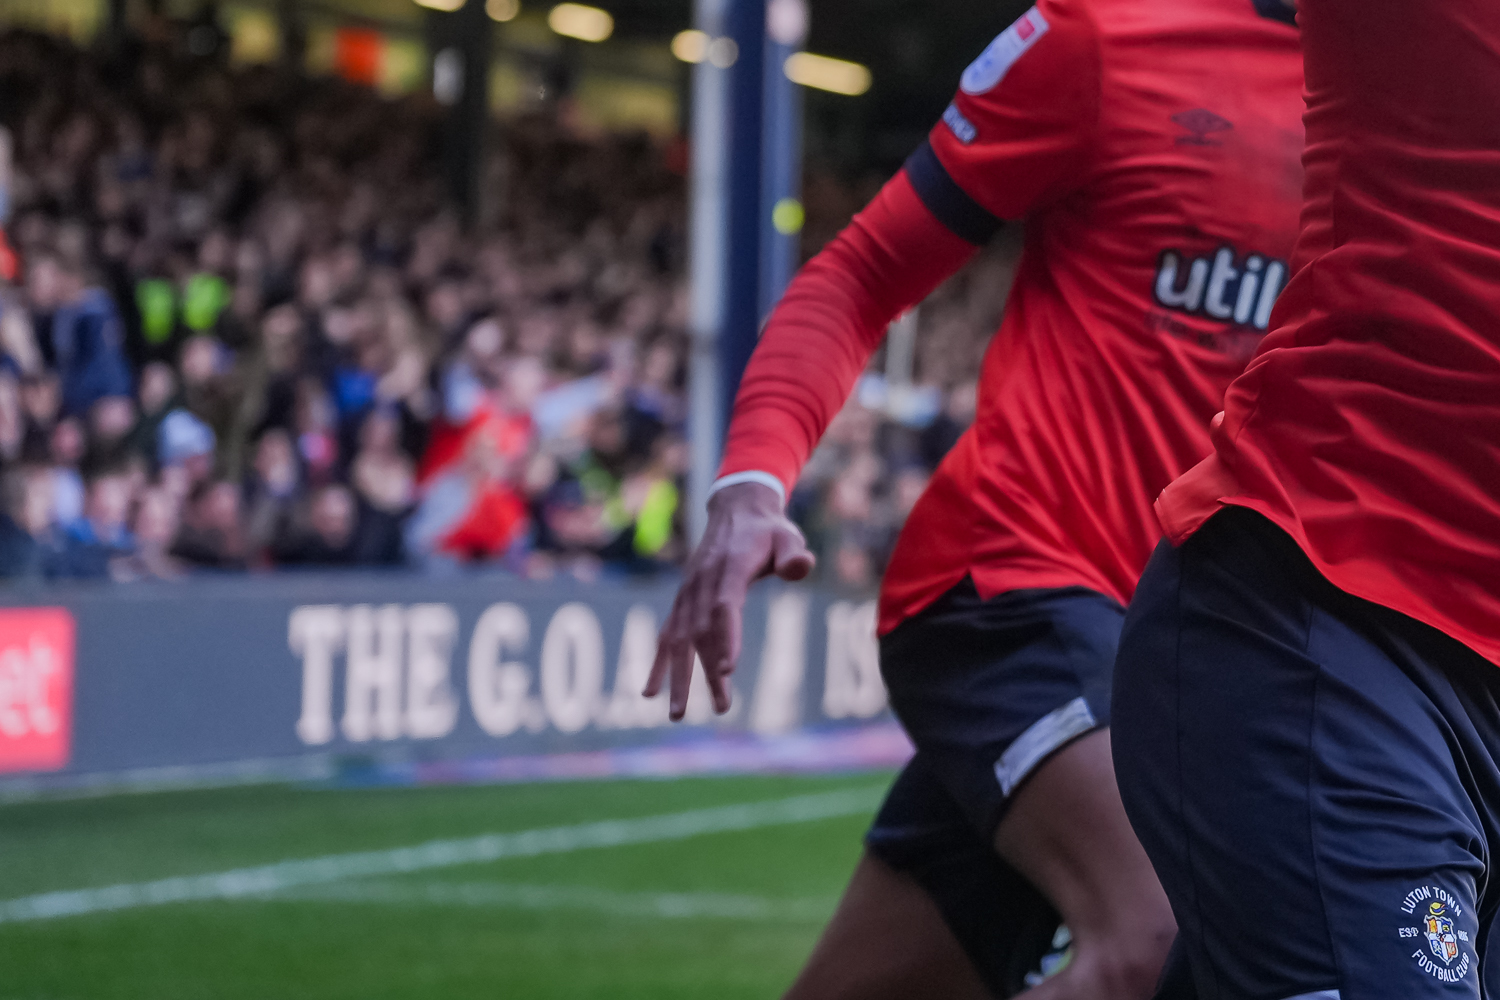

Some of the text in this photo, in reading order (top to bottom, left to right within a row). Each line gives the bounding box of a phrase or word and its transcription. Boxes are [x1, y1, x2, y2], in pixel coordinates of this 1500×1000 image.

[1154, 246, 1285, 331] util
[288, 602, 460, 741] THE
[1401, 886, 1462, 916] LUTON TOWN
[1411, 948, 1470, 983] FOOTBALL CLUB
